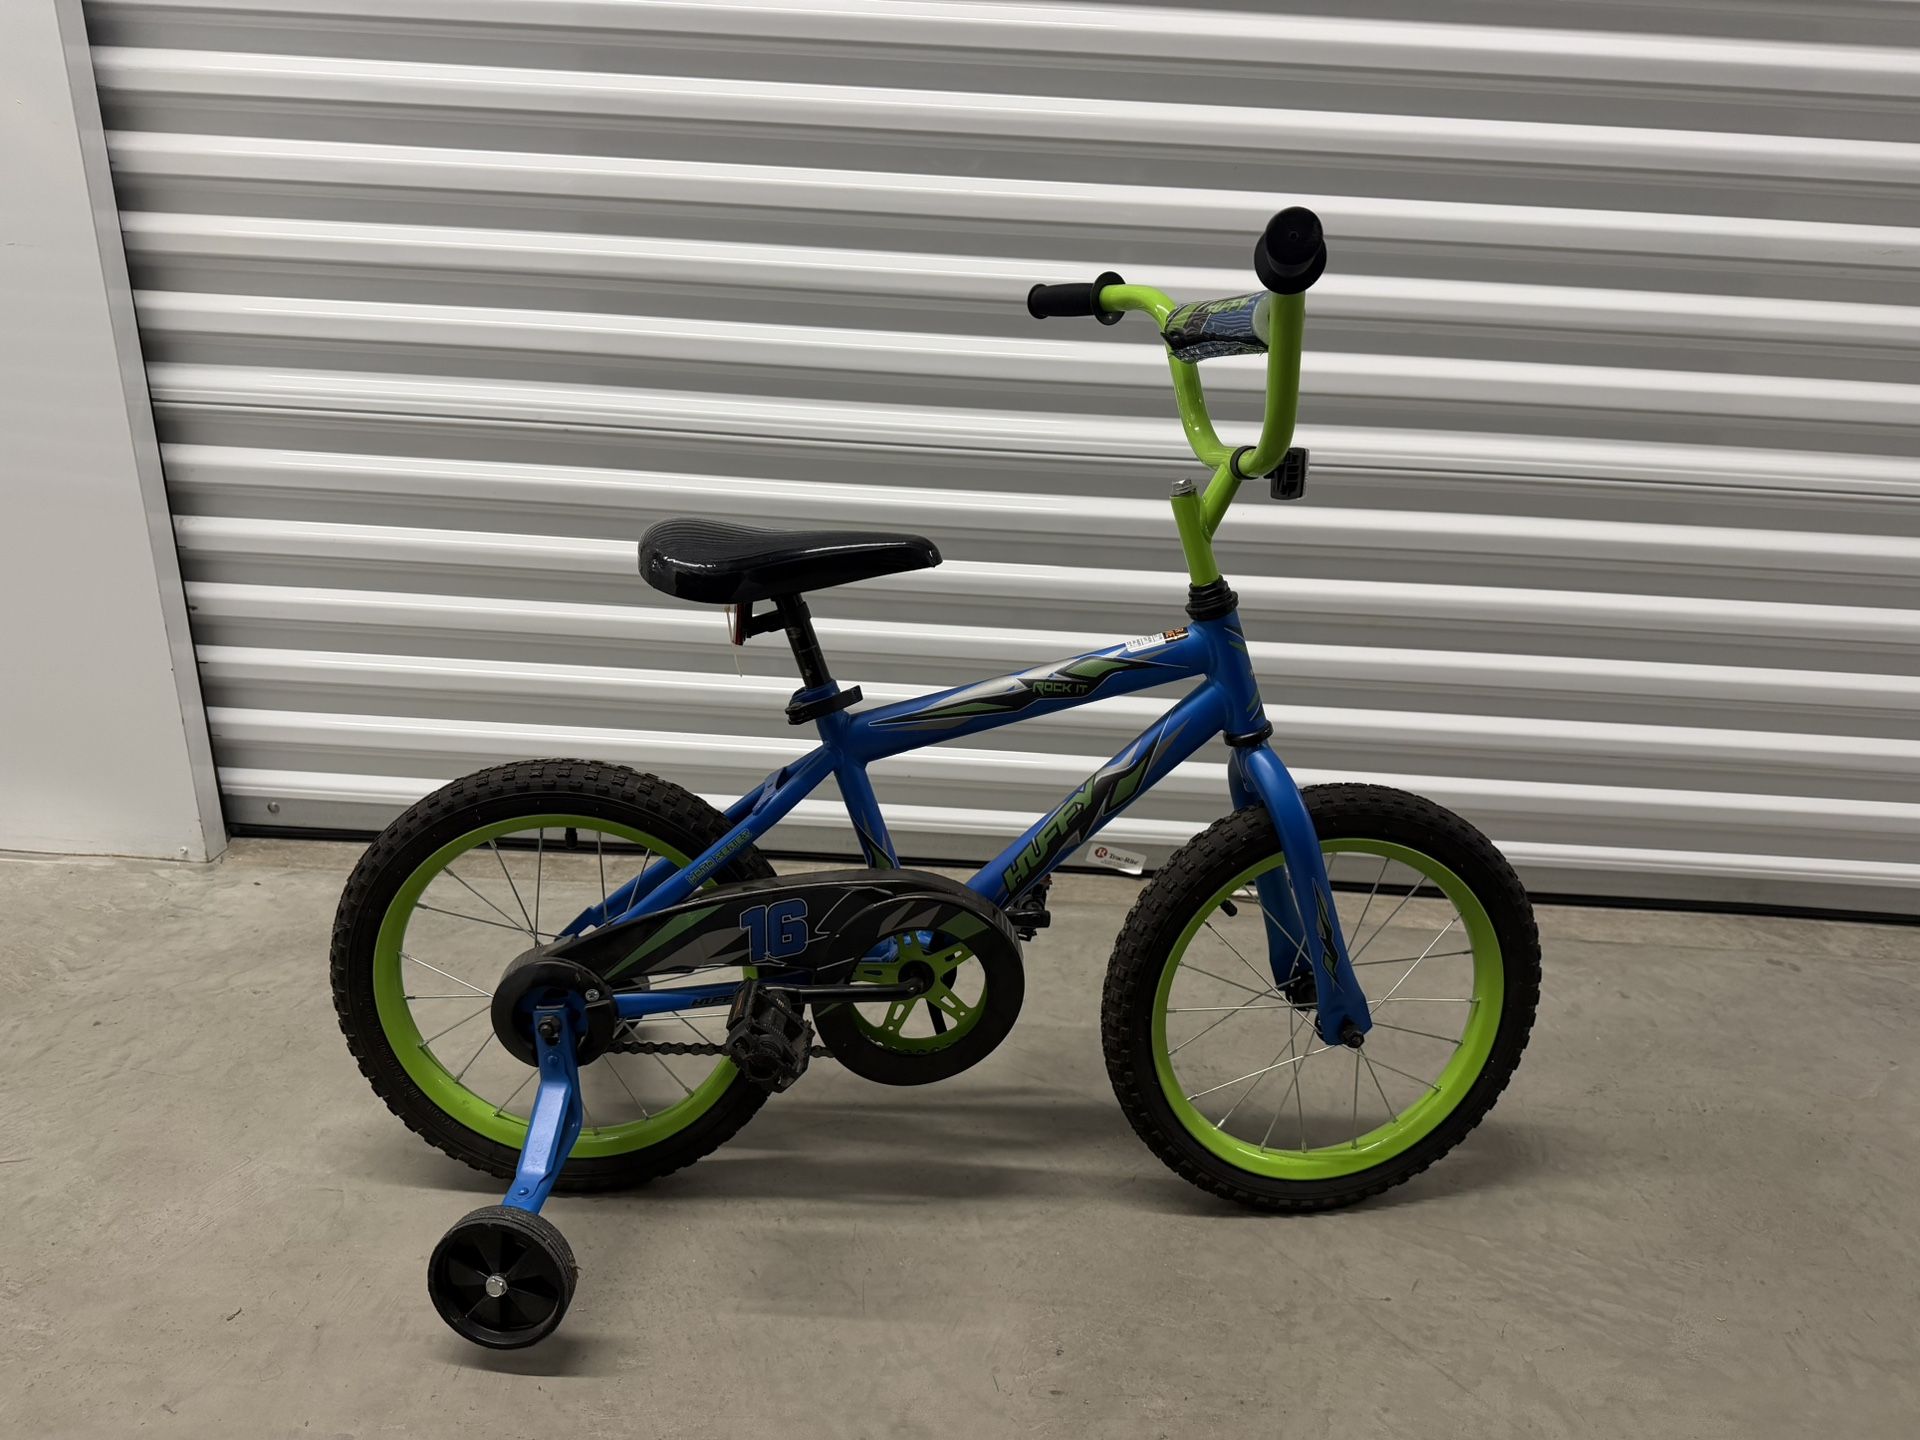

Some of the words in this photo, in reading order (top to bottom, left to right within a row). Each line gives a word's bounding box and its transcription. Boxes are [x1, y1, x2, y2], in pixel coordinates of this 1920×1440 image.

[1032, 680, 1071, 695] ROCK
[1075, 683, 1088, 694] IT
[1002, 773, 1097, 893] HUFFY
[687, 857, 714, 884] MOTO
[739, 898, 809, 964] 16
